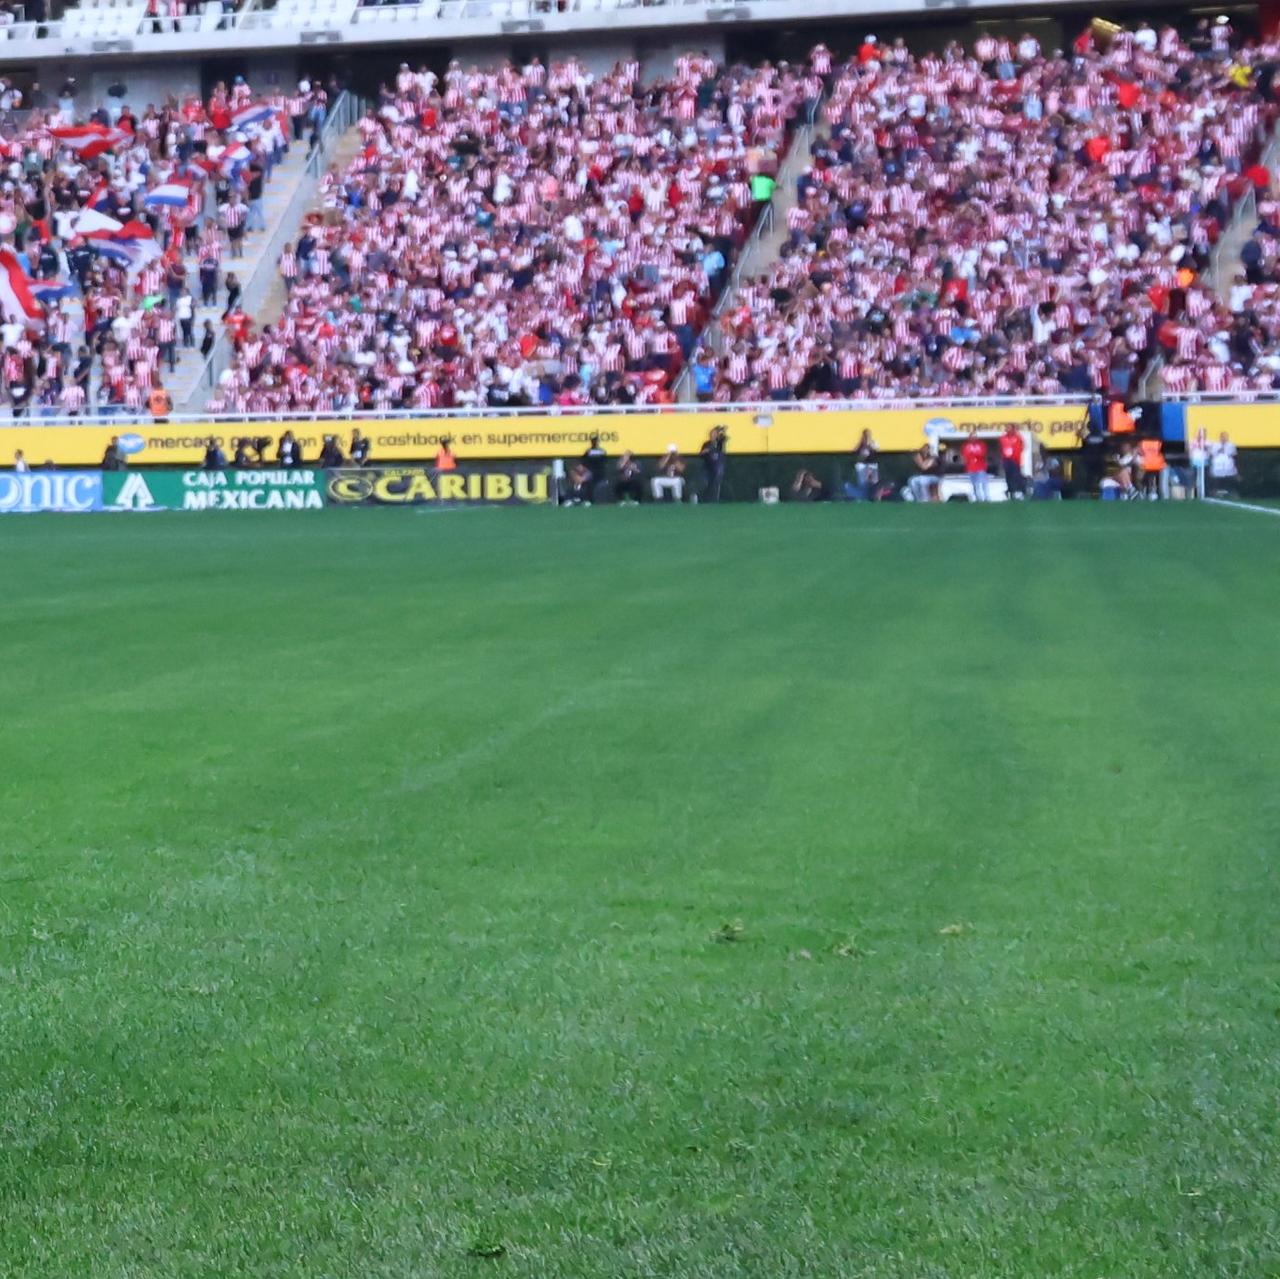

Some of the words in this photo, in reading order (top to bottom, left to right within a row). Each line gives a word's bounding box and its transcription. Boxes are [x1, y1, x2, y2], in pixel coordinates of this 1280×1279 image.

[462, 432, 483, 446] en
[182, 470, 227, 488] CAJA
[235, 470, 315, 486] POPULAR
[183, 489, 323, 510] MEXICANA
